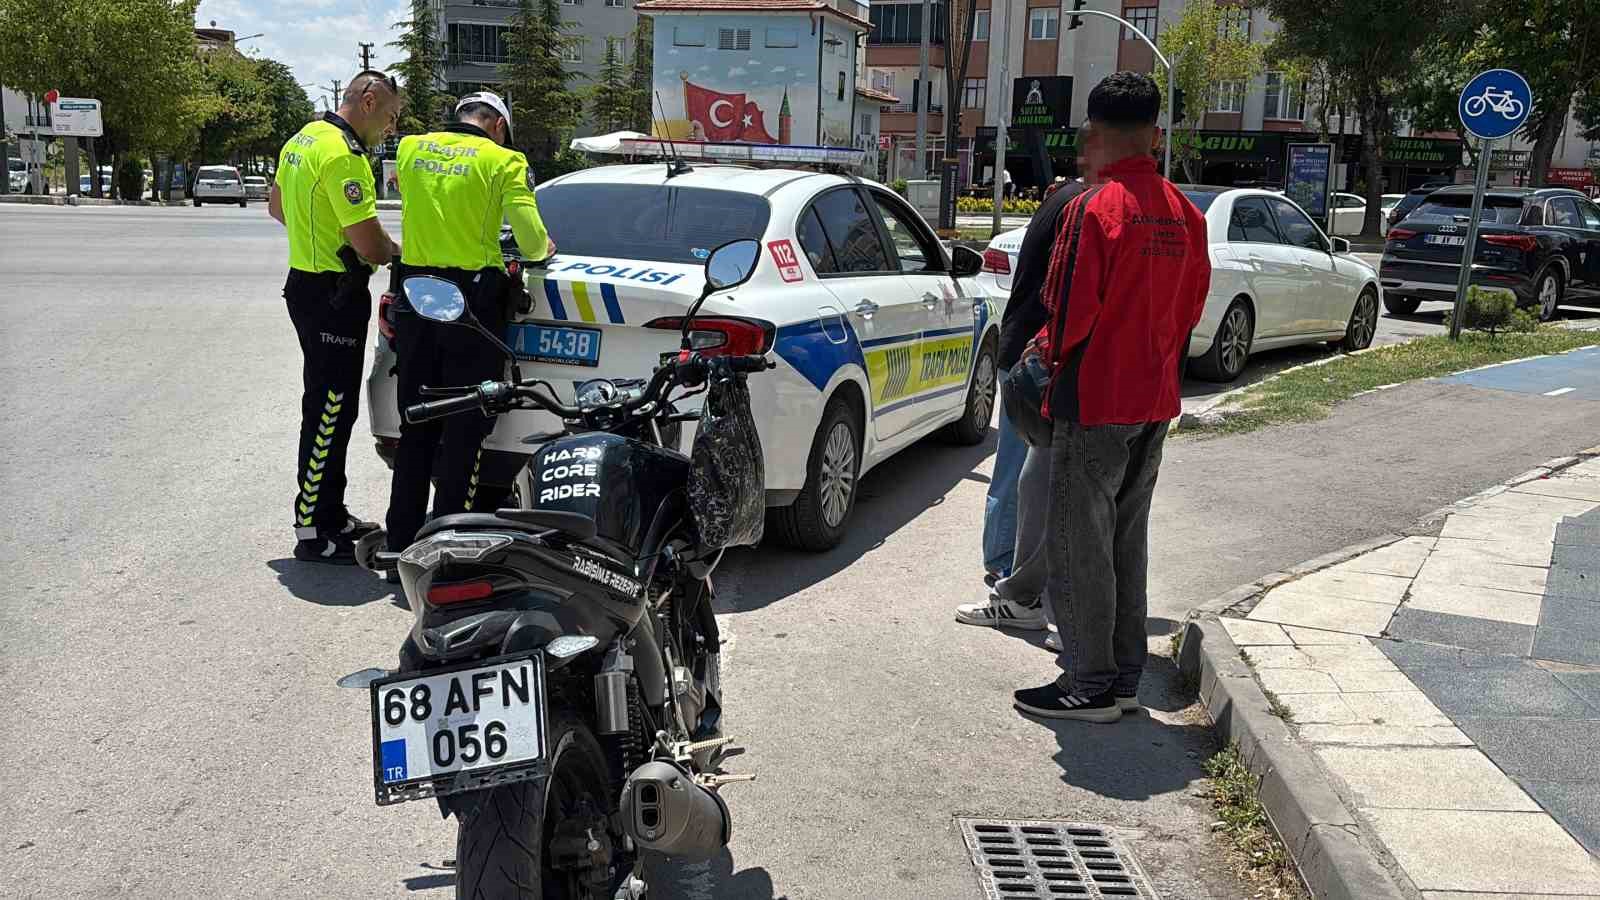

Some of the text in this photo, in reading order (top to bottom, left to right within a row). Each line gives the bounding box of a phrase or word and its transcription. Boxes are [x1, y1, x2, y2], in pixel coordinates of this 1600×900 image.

[772, 244, 795, 265] 112
[561, 262, 685, 286] POLİSİ
[538, 328, 592, 357] 5438
[543, 447, 602, 466] HARD
[542, 463, 597, 482] CORE
[540, 483, 601, 504] RIDER
[384, 666, 530, 725] 68 AFN
[433, 720, 508, 767] 056
[387, 766, 404, 780] TR
